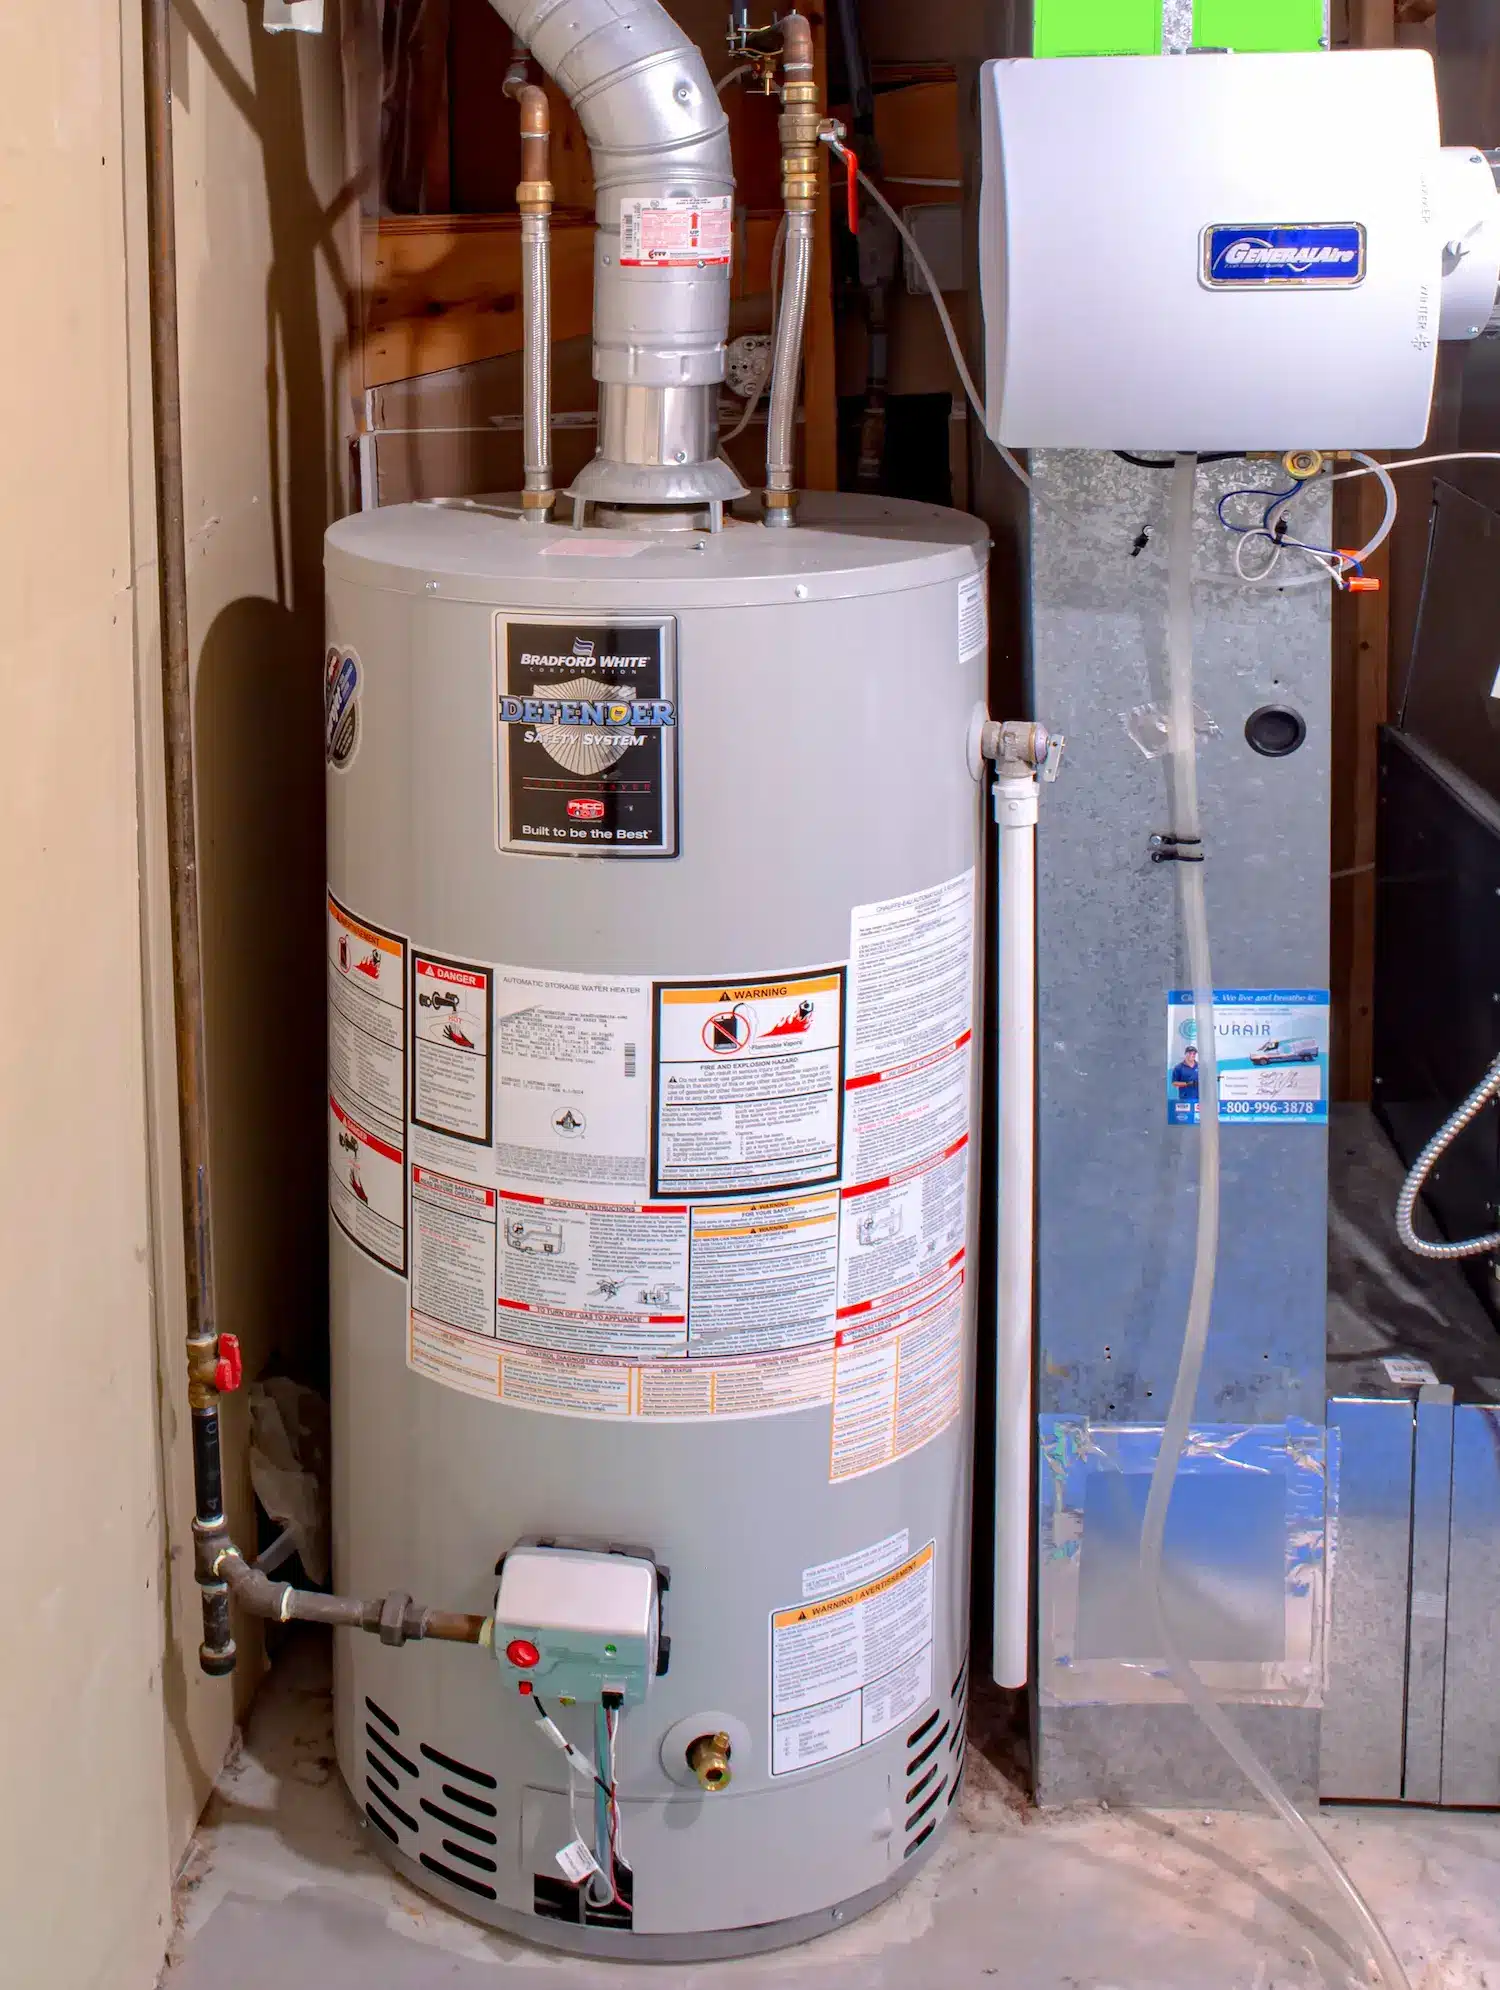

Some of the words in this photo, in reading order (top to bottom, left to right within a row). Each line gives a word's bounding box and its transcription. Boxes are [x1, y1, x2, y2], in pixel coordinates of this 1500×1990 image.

[521, 654, 596, 667] BRADFORD
[600, 656, 648, 668] WHITE
[499, 696, 676, 727] DEFENDER
[524, 731, 578, 744] SAFETY
[582, 733, 646, 746] SYSTEM
[569, 801, 603, 810] PHCC
[522, 825, 550, 836] Built
[553, 827, 566, 837] to
[570, 828, 586, 838] be
[590, 829, 610, 839] the
[616, 830, 649, 839] Best
[437, 967, 477, 986] DANGER
[503, 977, 543, 987] AUTOMATIC
[545, 982, 580, 990] STORAGE
[734, 987, 788, 999] WARNING
[1213, 1024, 1271, 1036] URAIR
[772, 1057, 798, 1065] HAZARD
[549, 1200, 585, 1210] OPERATING
[587, 1204, 635, 1212] INSTRUCTIONS
[759, 1224, 788, 1232] WARNING
[537, 1306, 547, 1314] TO
[548, 1308, 564, 1316] TURN
[605, 1315, 641, 1323] APPLIANCE
[525, 1350, 553, 1358] CONTROL
[557, 1354, 595, 1364] DIAGNOSTIC
[812, 1596, 854, 1616] WARNING
[860, 1561, 917, 1599] AVERTISSEMENT
